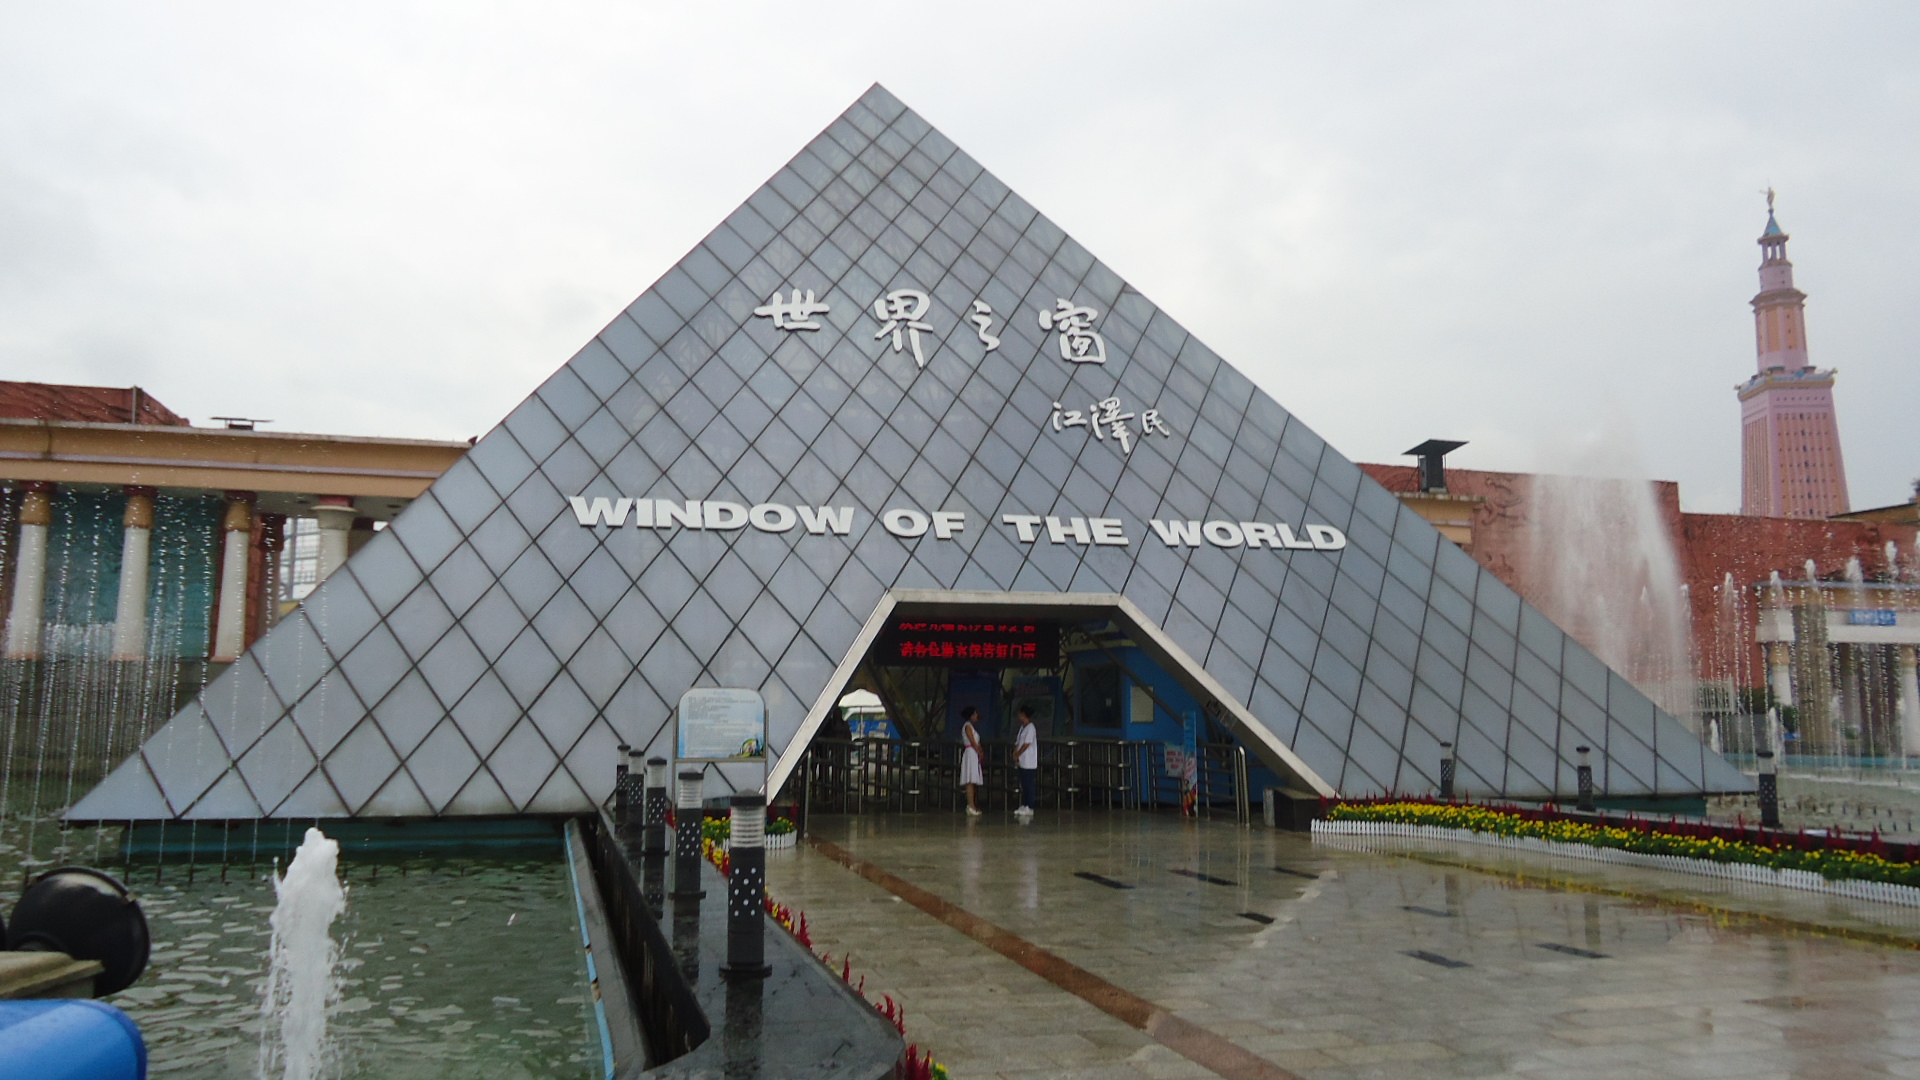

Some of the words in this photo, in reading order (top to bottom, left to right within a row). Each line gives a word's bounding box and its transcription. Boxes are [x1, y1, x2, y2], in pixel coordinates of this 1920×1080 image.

[754, 288, 1107, 370] 世界之窗
[569, 495, 855, 536] WINDOW
[883, 508, 965, 540] OF
[1002, 514, 1130, 546] THE
[1148, 519, 1347, 552] WORLD
